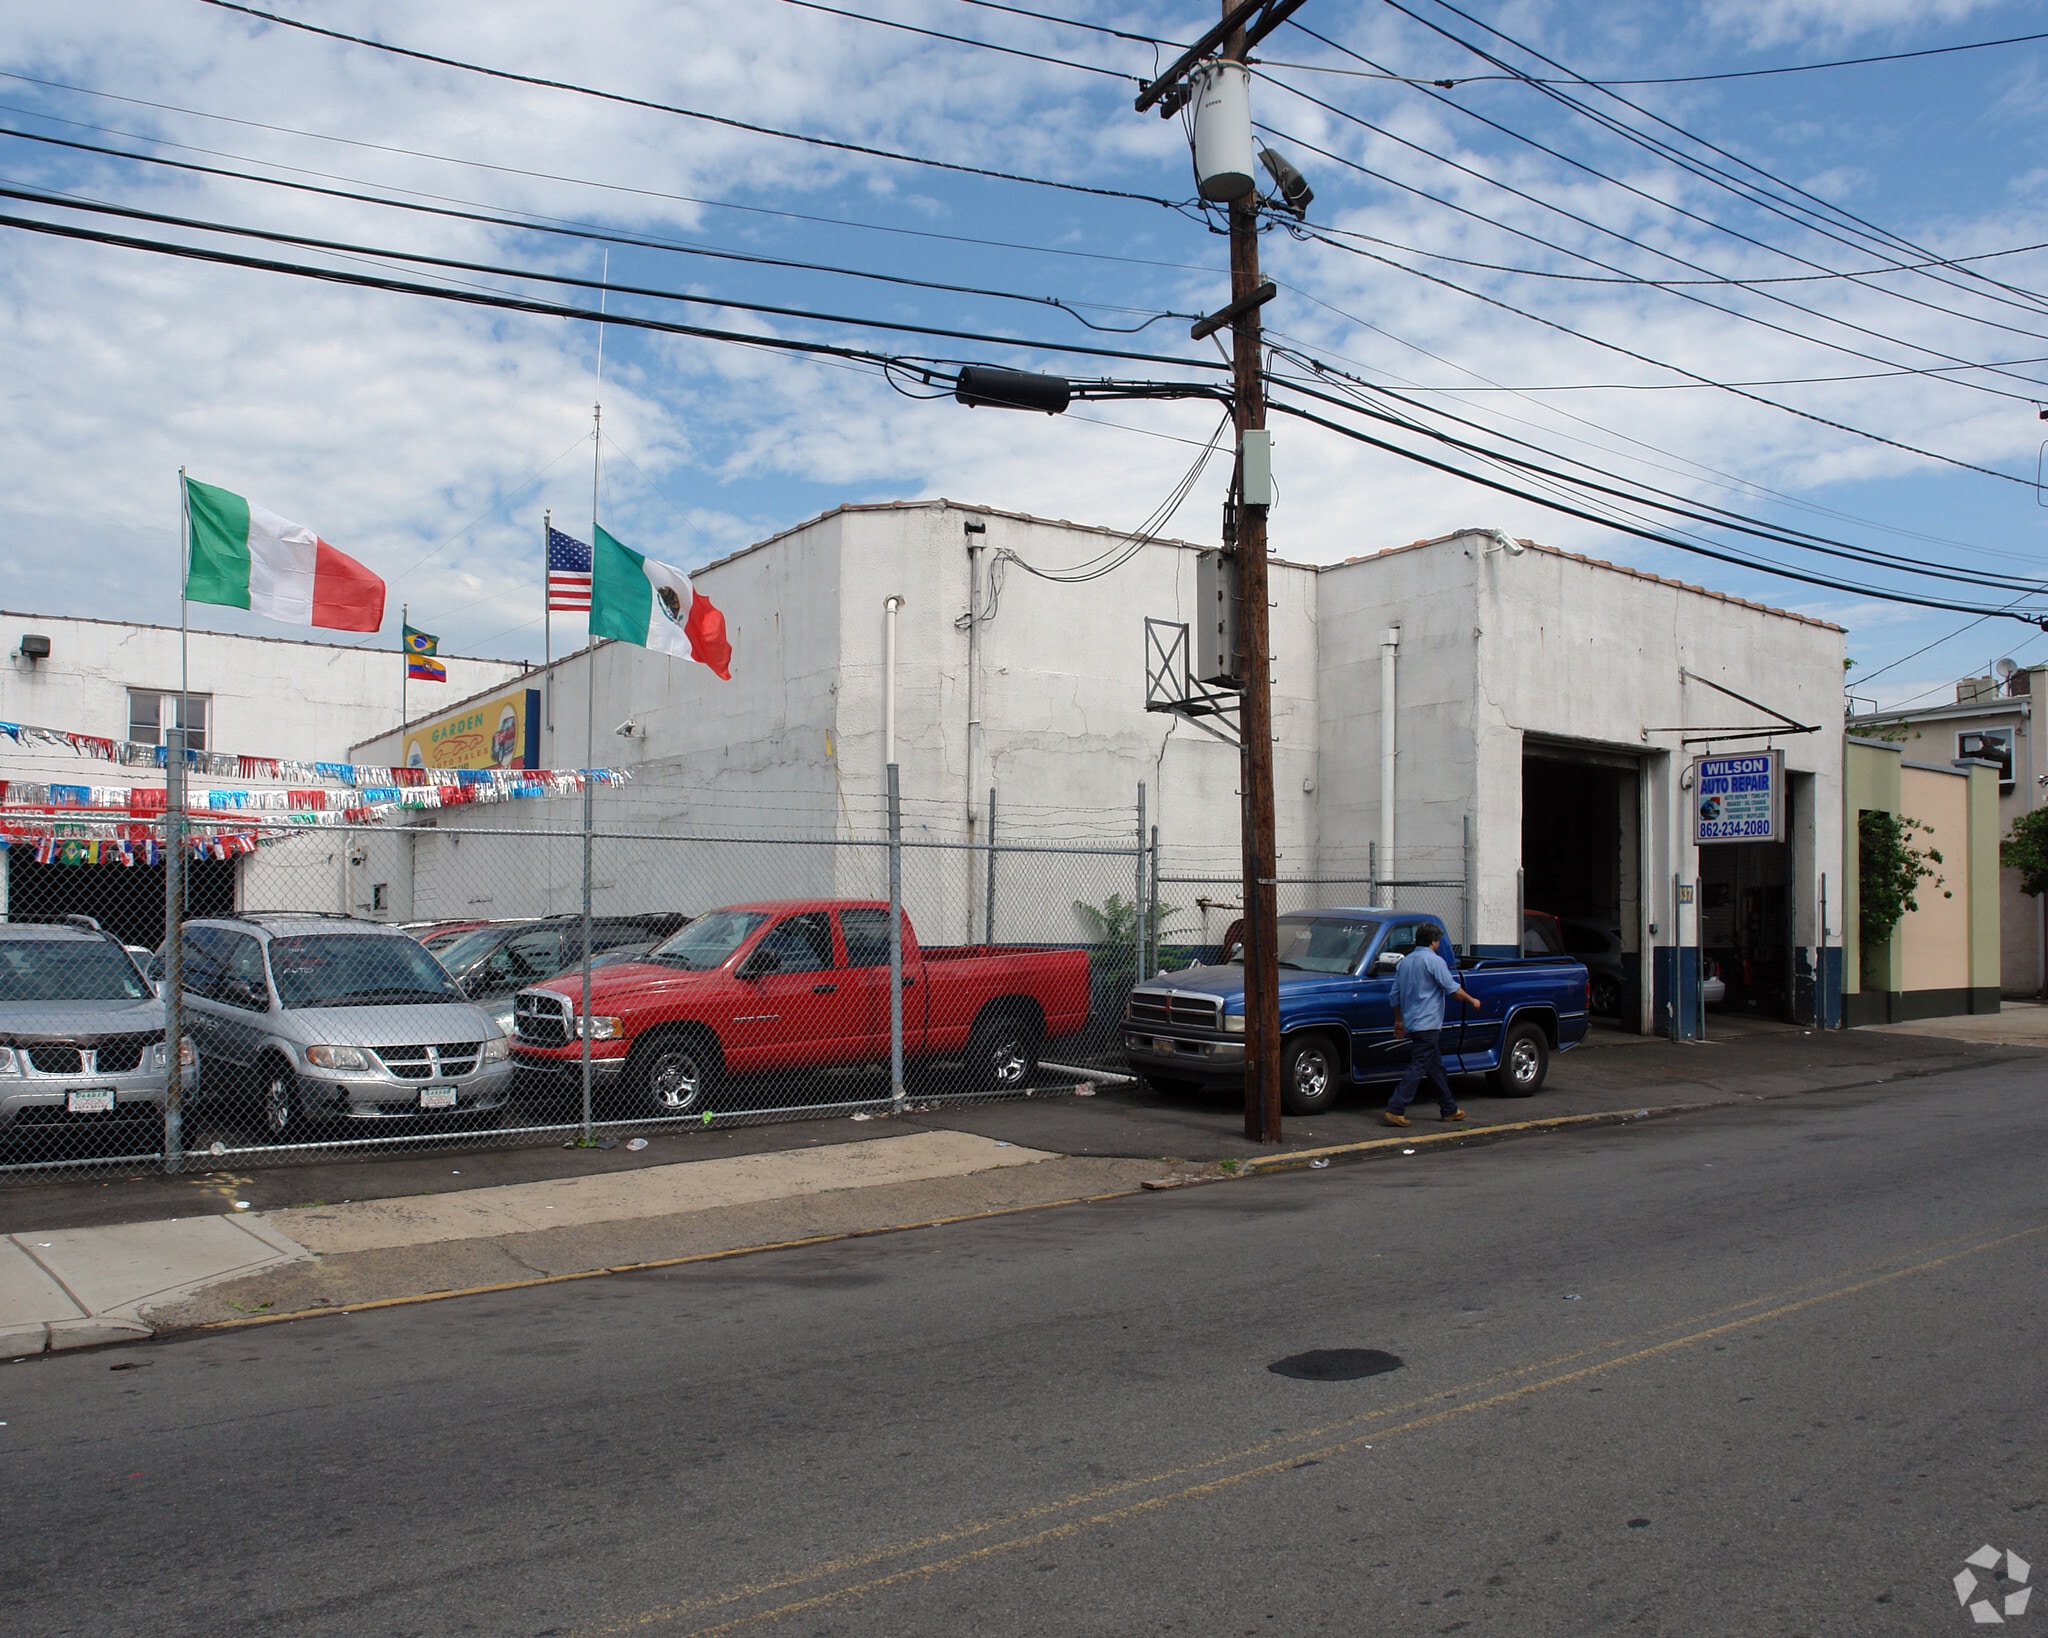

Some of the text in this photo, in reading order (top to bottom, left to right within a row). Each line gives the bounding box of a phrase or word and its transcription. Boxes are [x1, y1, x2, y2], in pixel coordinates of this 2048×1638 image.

[431, 713, 484, 742] GARDEN
[431, 747, 489, 769] AUTO SALES
[1706, 760, 1763, 775] WILSON
[1700, 775, 1769, 795] AUTO REPAIR
[1700, 820, 1770, 837] 862-234-2080
